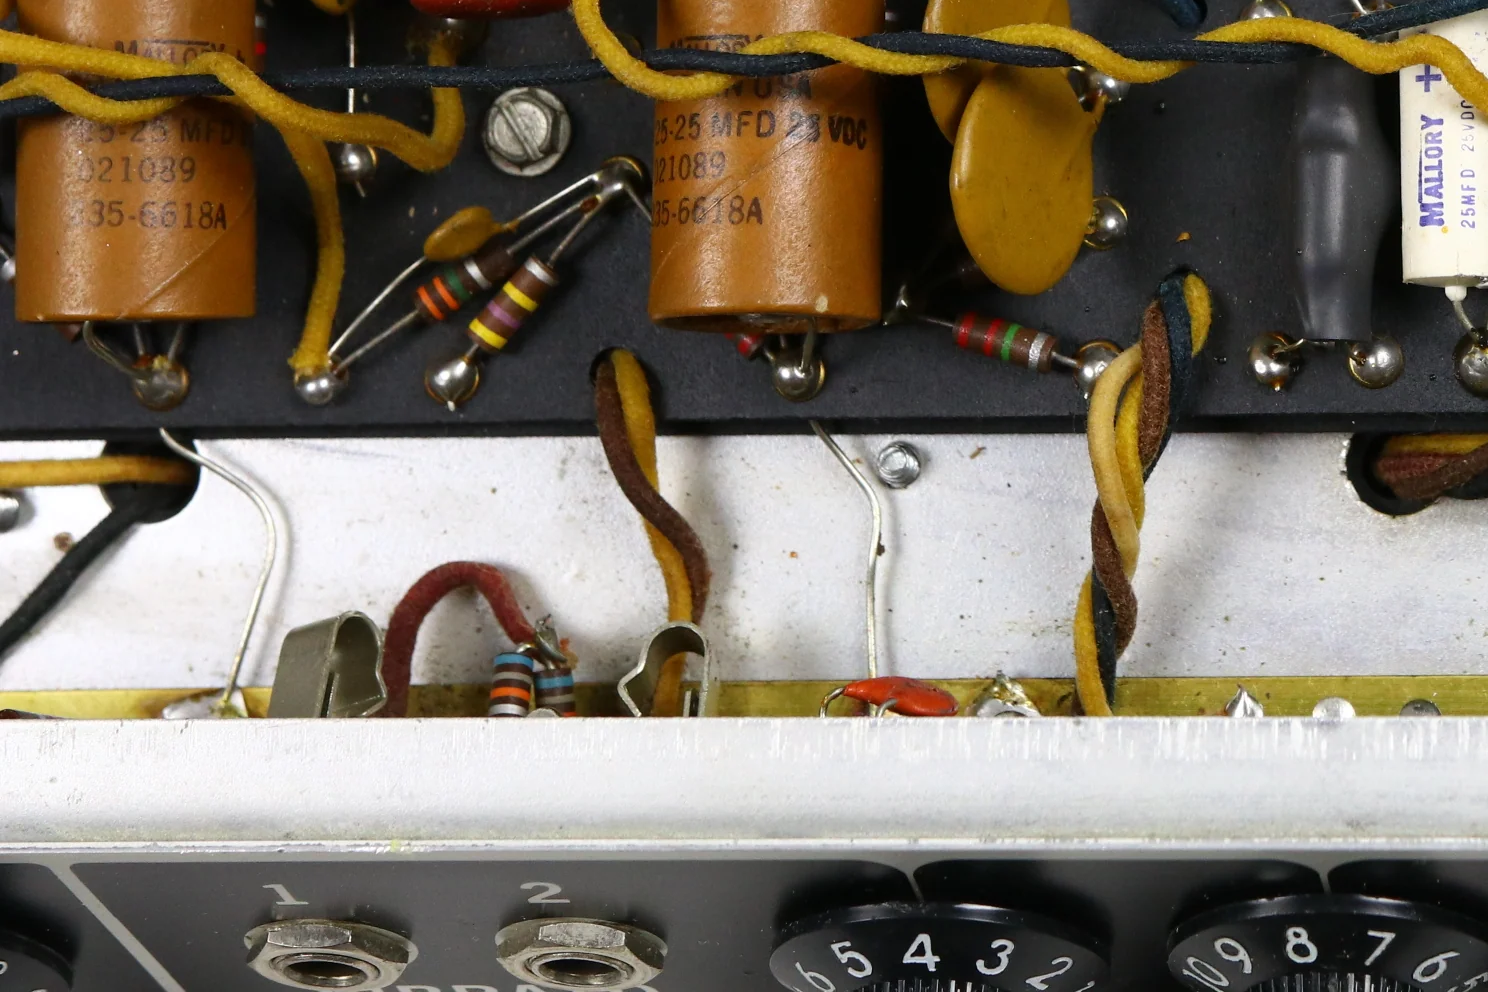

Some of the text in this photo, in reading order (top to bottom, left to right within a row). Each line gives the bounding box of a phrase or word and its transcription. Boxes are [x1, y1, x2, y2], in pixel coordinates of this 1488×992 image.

[655, 112, 700, 145] 25-25
[711, 109, 776, 138] MFD
[828, 115, 868, 150] VDC
[1418, 114, 1445, 227] MALLORY
[651, 195, 764, 227] 35-6618A
[262, 883, 309, 905] 1
[520, 881, 571, 904] 2
[830, 941, 873, 978] 5
[903, 934, 941, 972] 4
[976, 939, 1014, 975] 3
[1025, 957, 1074, 990] 2
[1182, 956, 1230, 992] 10
[1214, 937, 1252, 974] 9
[1285, 927, 1318, 963] 8
[1367, 930, 1396, 966] 7
[1413, 951, 1460, 982] 6
